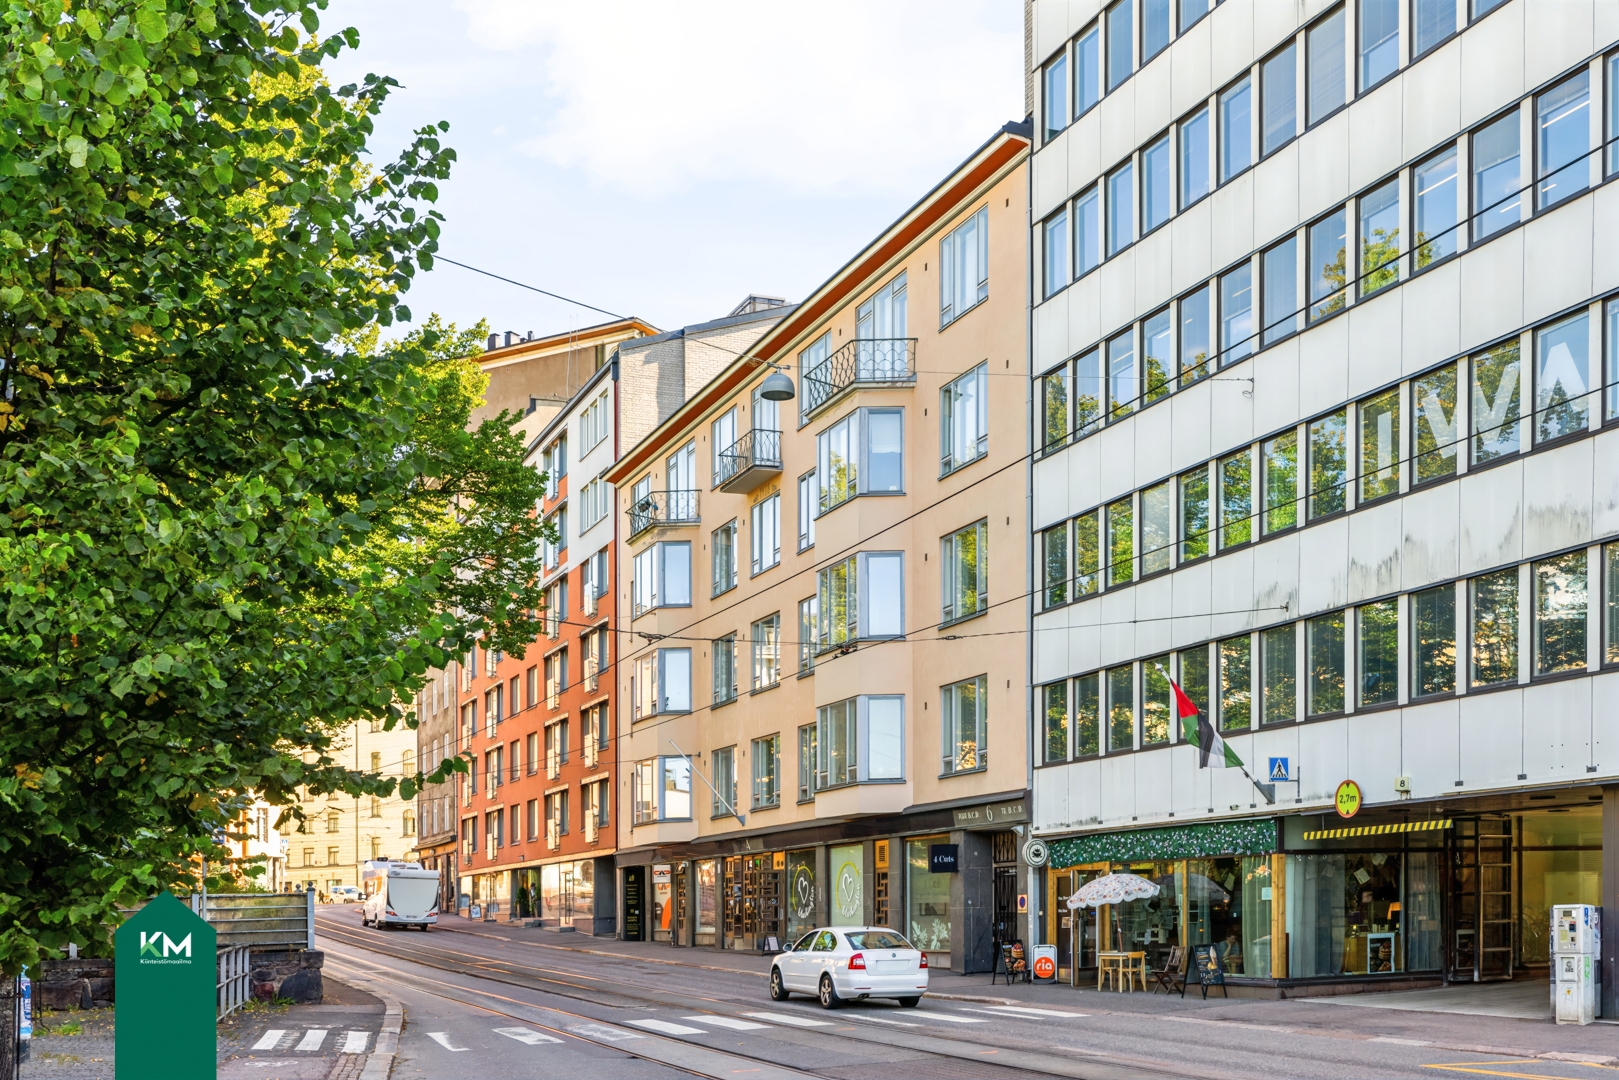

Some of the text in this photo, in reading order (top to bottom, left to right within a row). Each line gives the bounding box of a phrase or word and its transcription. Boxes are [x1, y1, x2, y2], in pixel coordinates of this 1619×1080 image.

[1340, 794, 1356, 804] 2,7m
[986, 805, 993, 821] 6
[933, 855, 954, 863] 4 Cuts
[1036, 959, 1053, 970] ria
